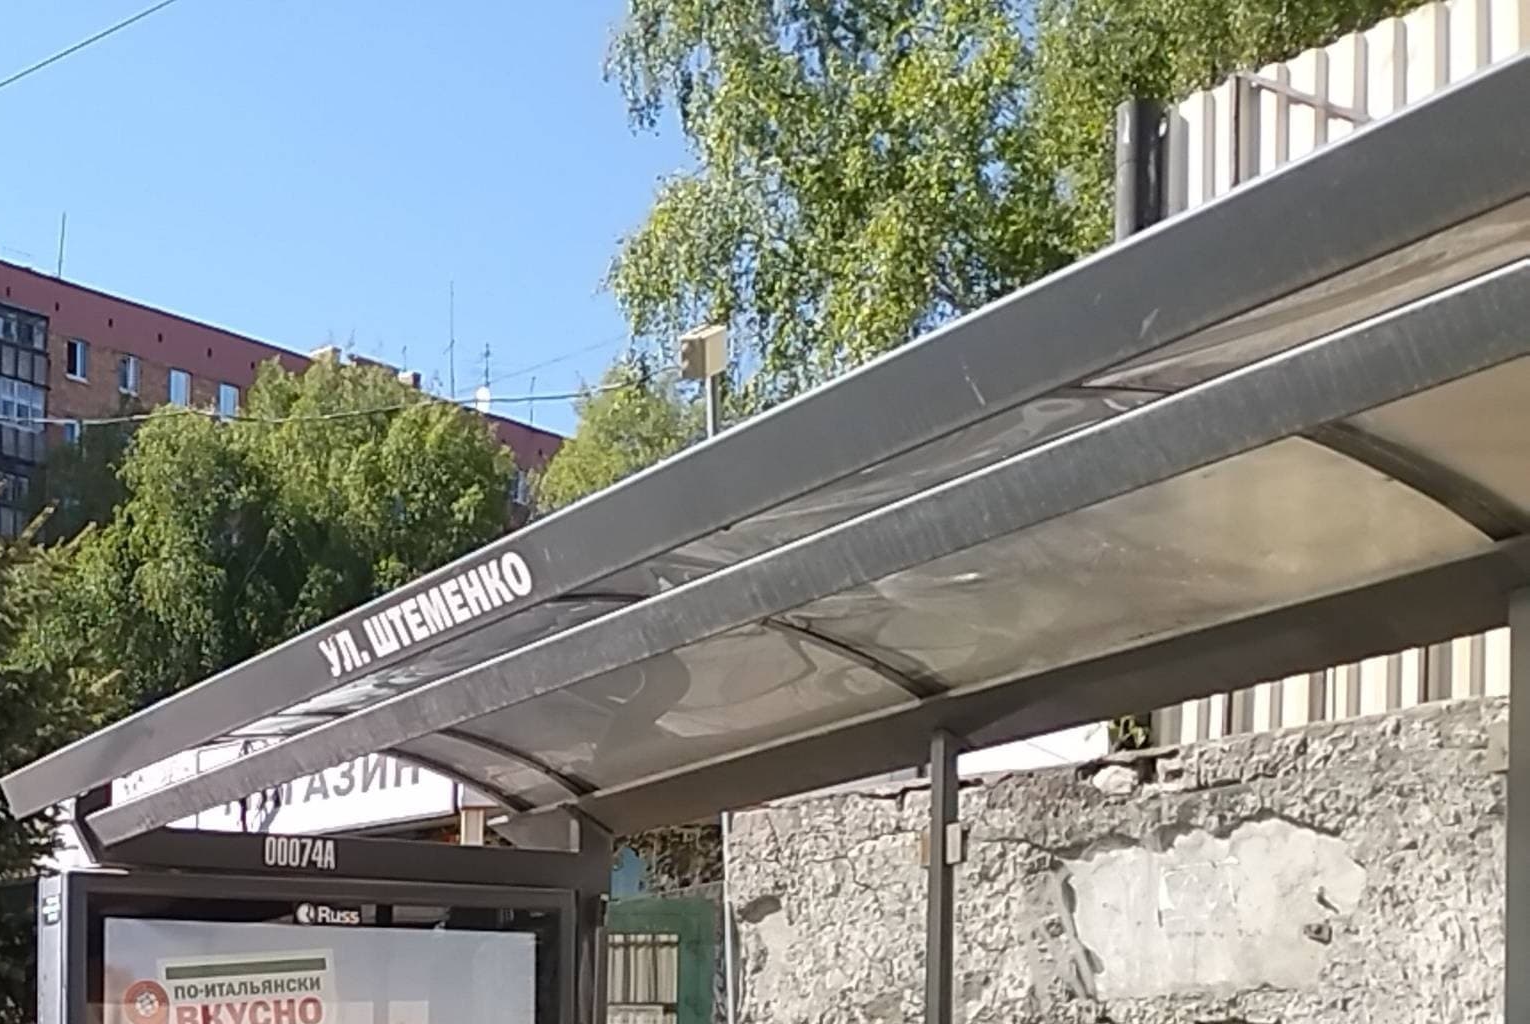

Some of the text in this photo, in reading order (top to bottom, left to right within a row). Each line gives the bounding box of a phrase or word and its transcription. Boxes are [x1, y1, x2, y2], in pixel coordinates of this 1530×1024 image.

[319, 551, 533, 677] УЛ. ШТЕМЕНКО
[317, 905, 359, 924] Russ
[174, 977, 321, 1000] ПО-ИТАЛЬЯНСКИ
